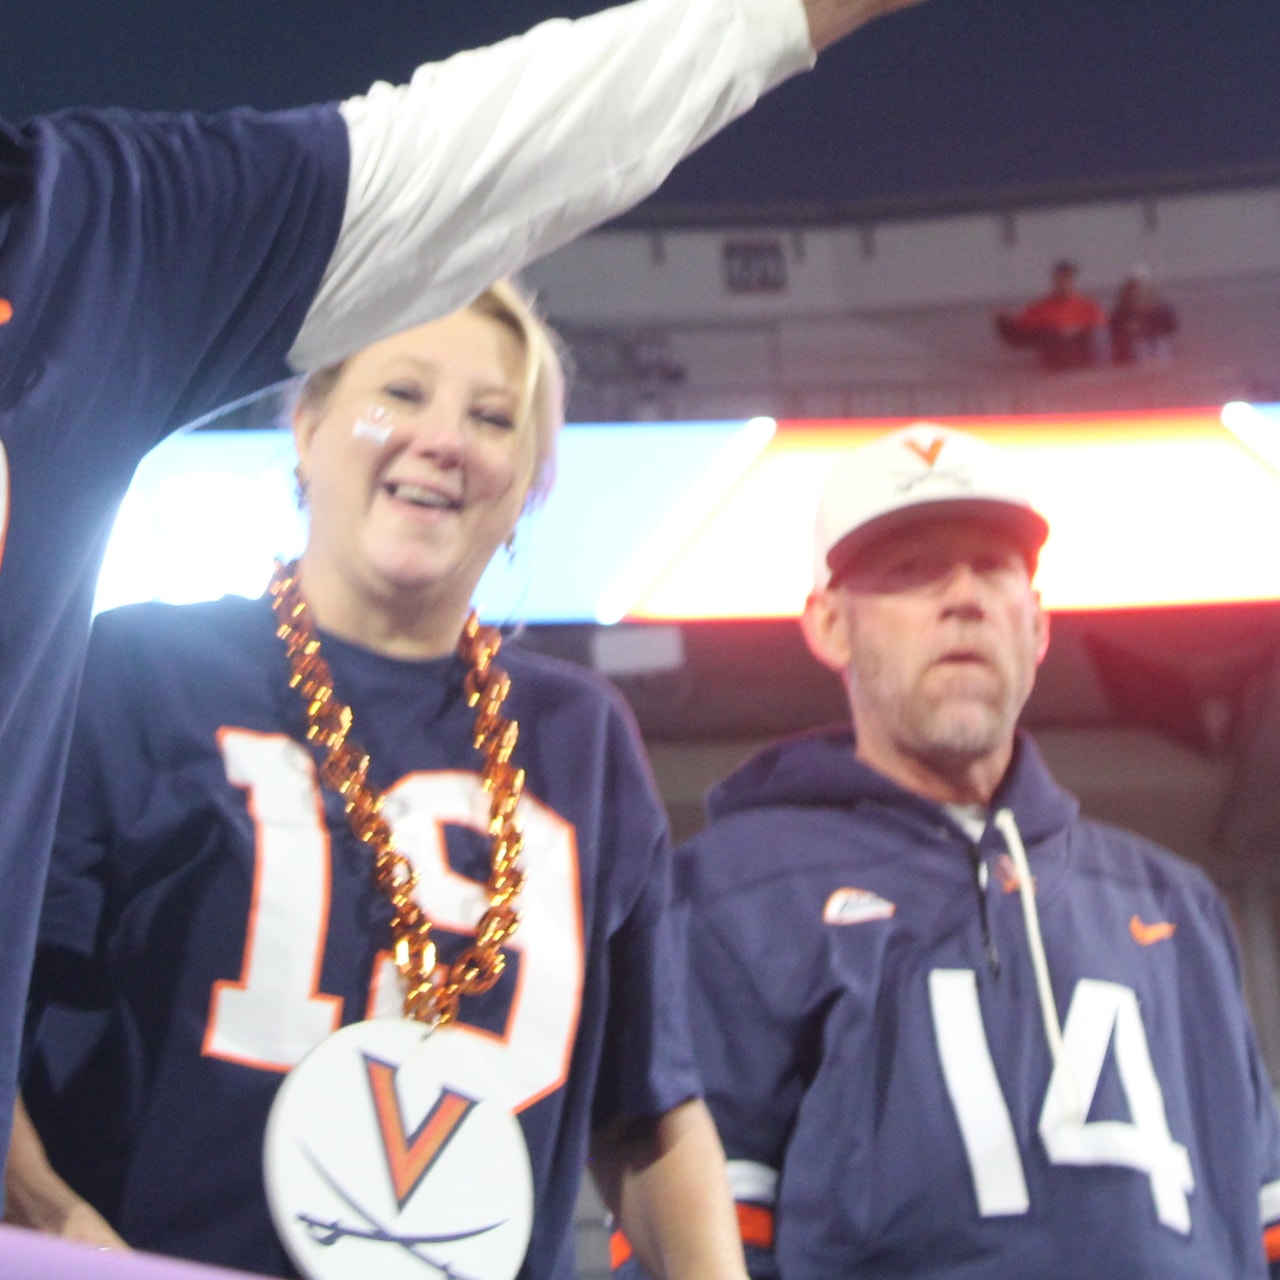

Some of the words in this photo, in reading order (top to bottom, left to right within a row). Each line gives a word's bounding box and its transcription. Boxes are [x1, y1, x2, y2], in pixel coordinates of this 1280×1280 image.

[202, 725, 585, 1116] 19
[360, 1049, 484, 1216] V
[928, 967, 1195, 1237] 14
